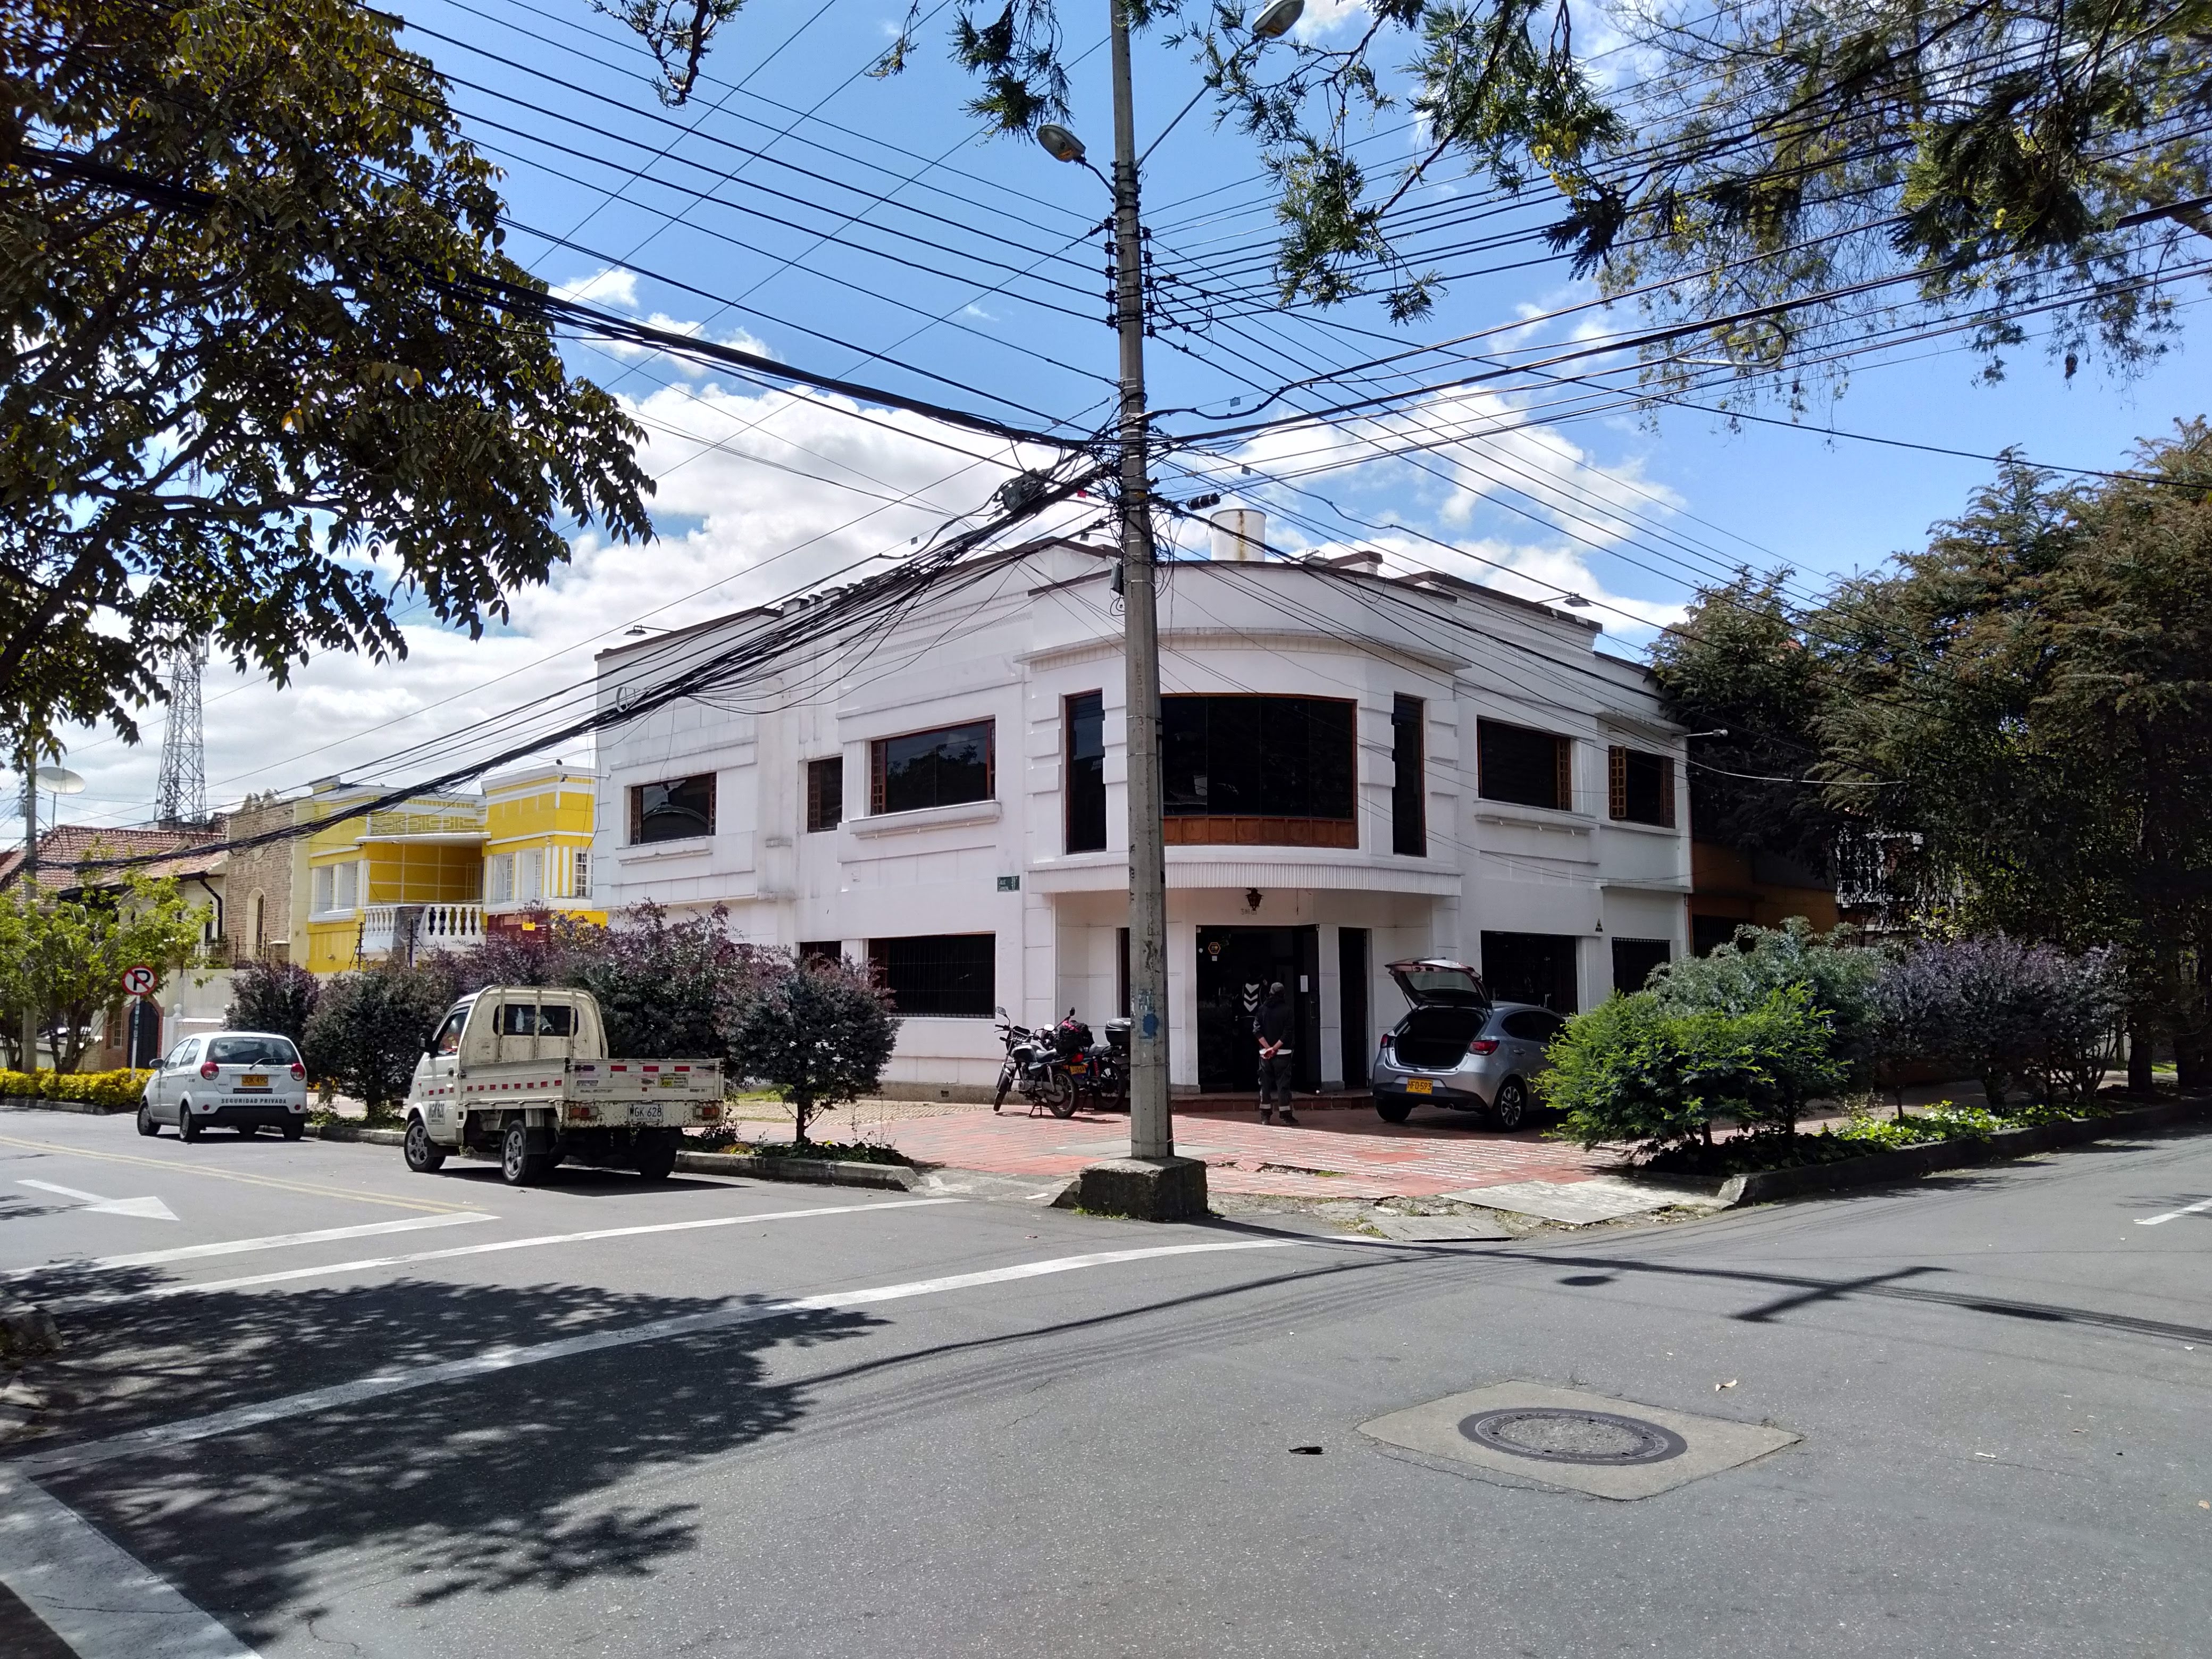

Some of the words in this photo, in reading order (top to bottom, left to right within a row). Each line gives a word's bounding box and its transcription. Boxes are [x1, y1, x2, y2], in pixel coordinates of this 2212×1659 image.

[133, 970, 150, 991] P
[630, 1107, 644, 1117] WGK
[647, 1107, 662, 1117] 628
